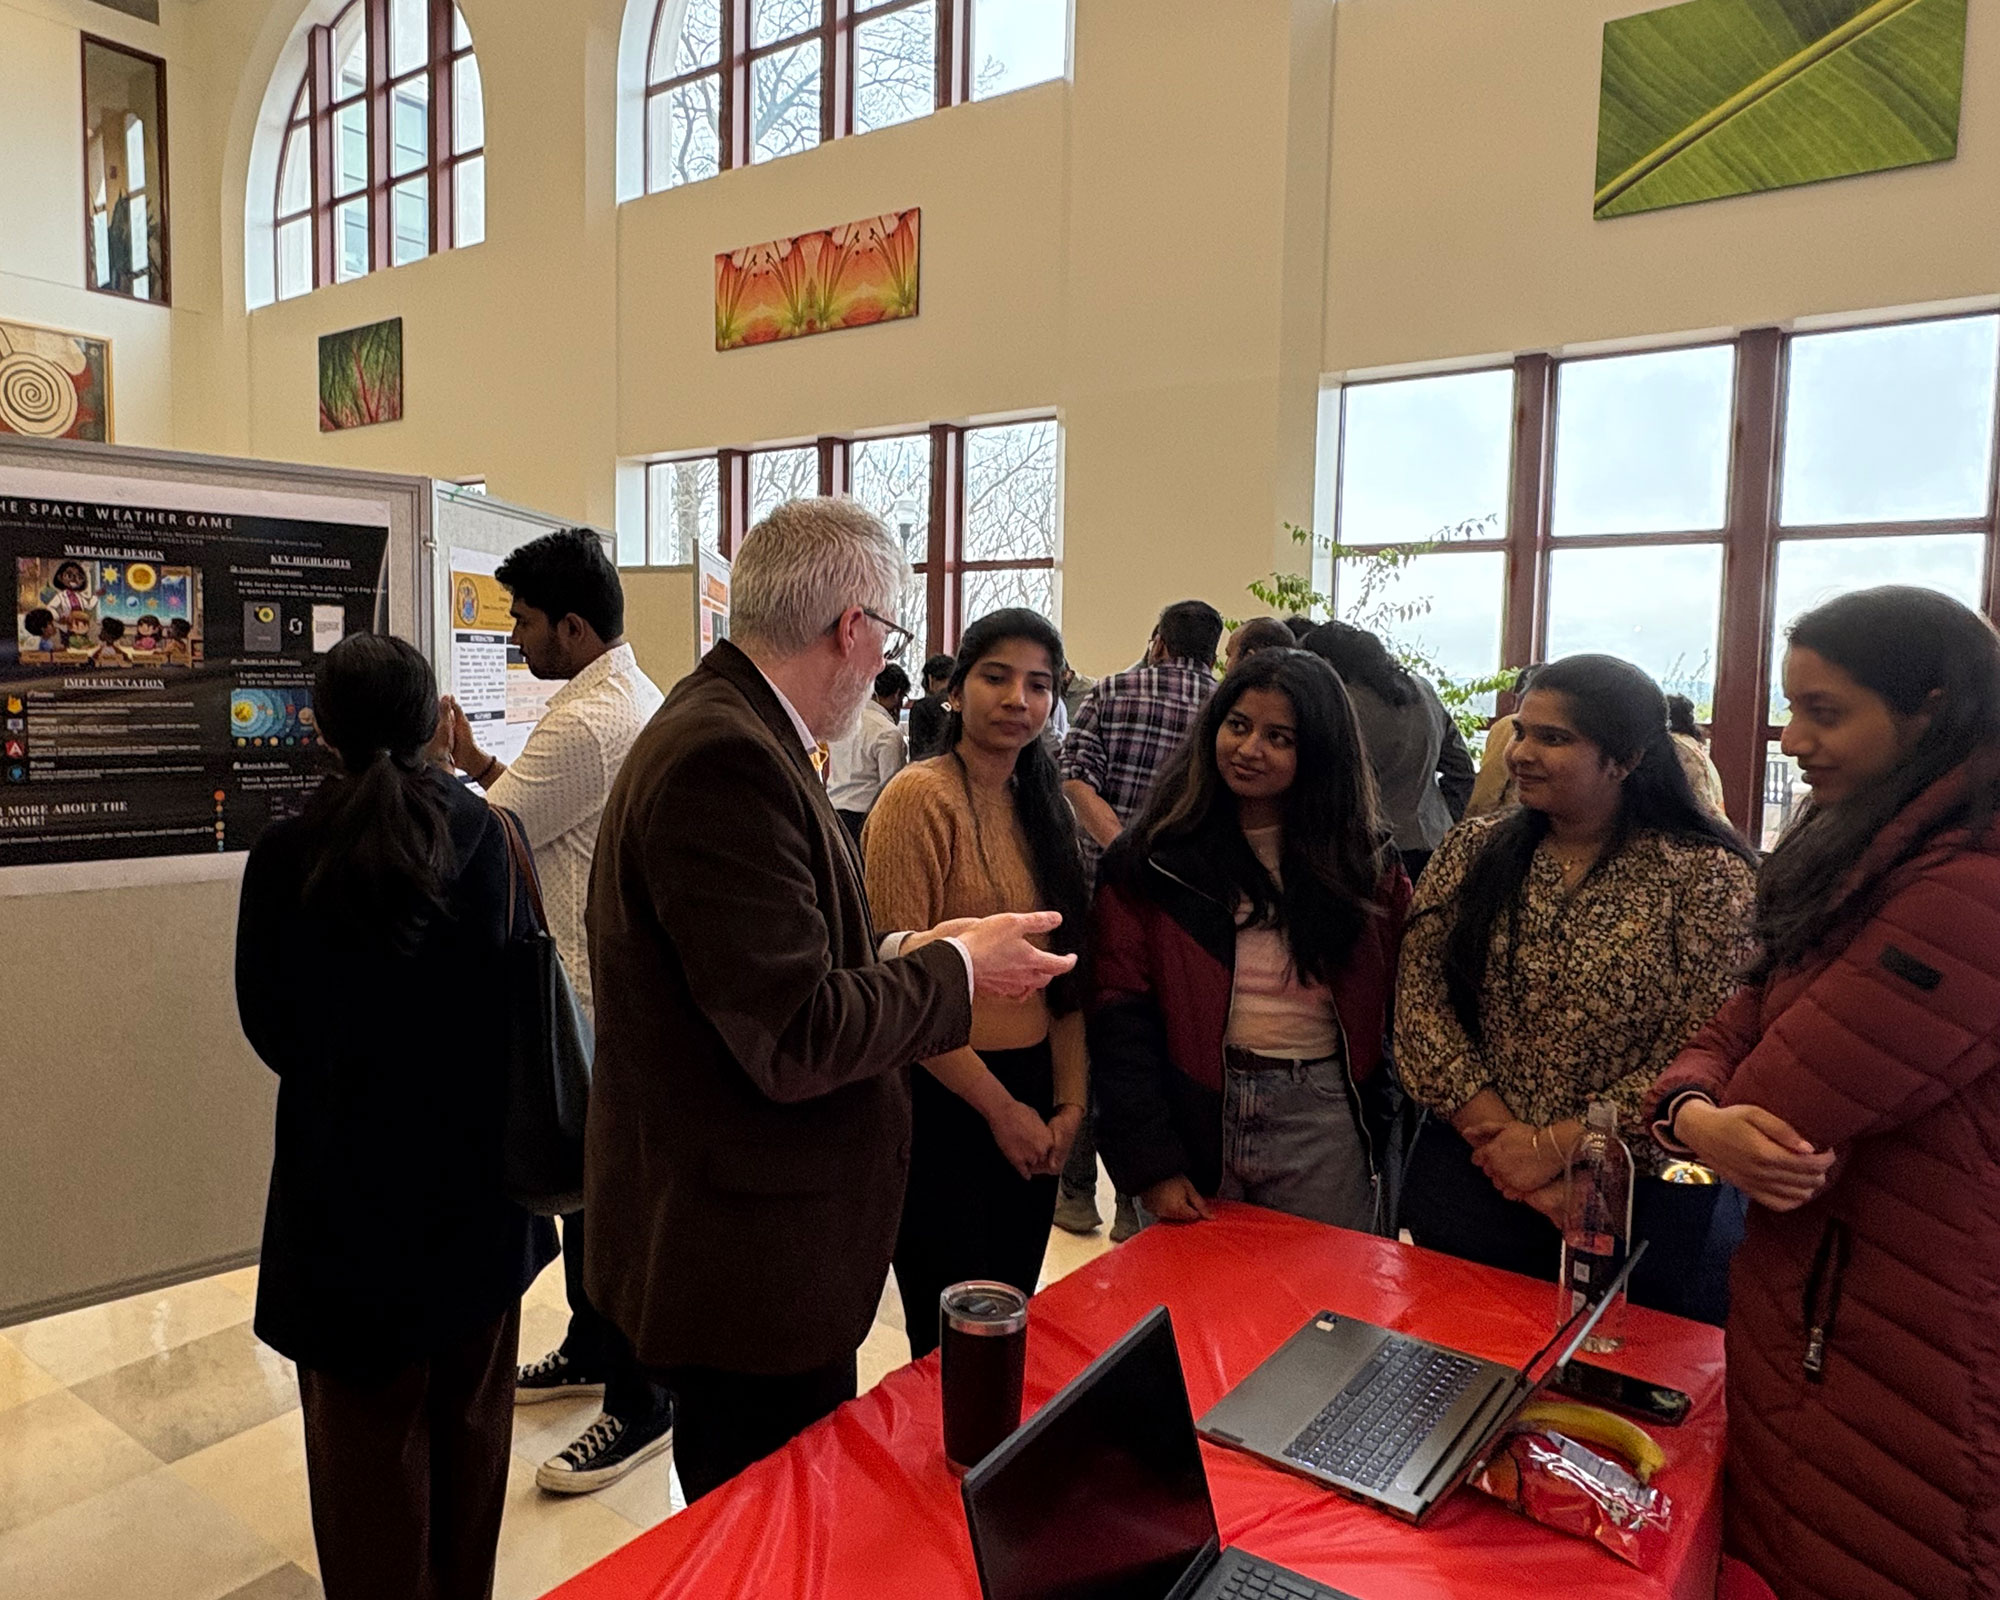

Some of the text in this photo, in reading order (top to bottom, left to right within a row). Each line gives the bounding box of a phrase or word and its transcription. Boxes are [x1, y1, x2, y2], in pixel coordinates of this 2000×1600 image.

[29, 502, 85, 519] SPACE
[96, 508, 178, 526] WEATHER
[186, 514, 233, 530] GAME
[64, 544, 165, 561] WEBPAGE DESIGN
[270, 554, 352, 569] KEY HIGHLIGHTS
[64, 678, 165, 690] IMPLEMENTATION
[8, 801, 129, 816] MORE ABOUT THE
[0, 816, 45, 828] GAME!
